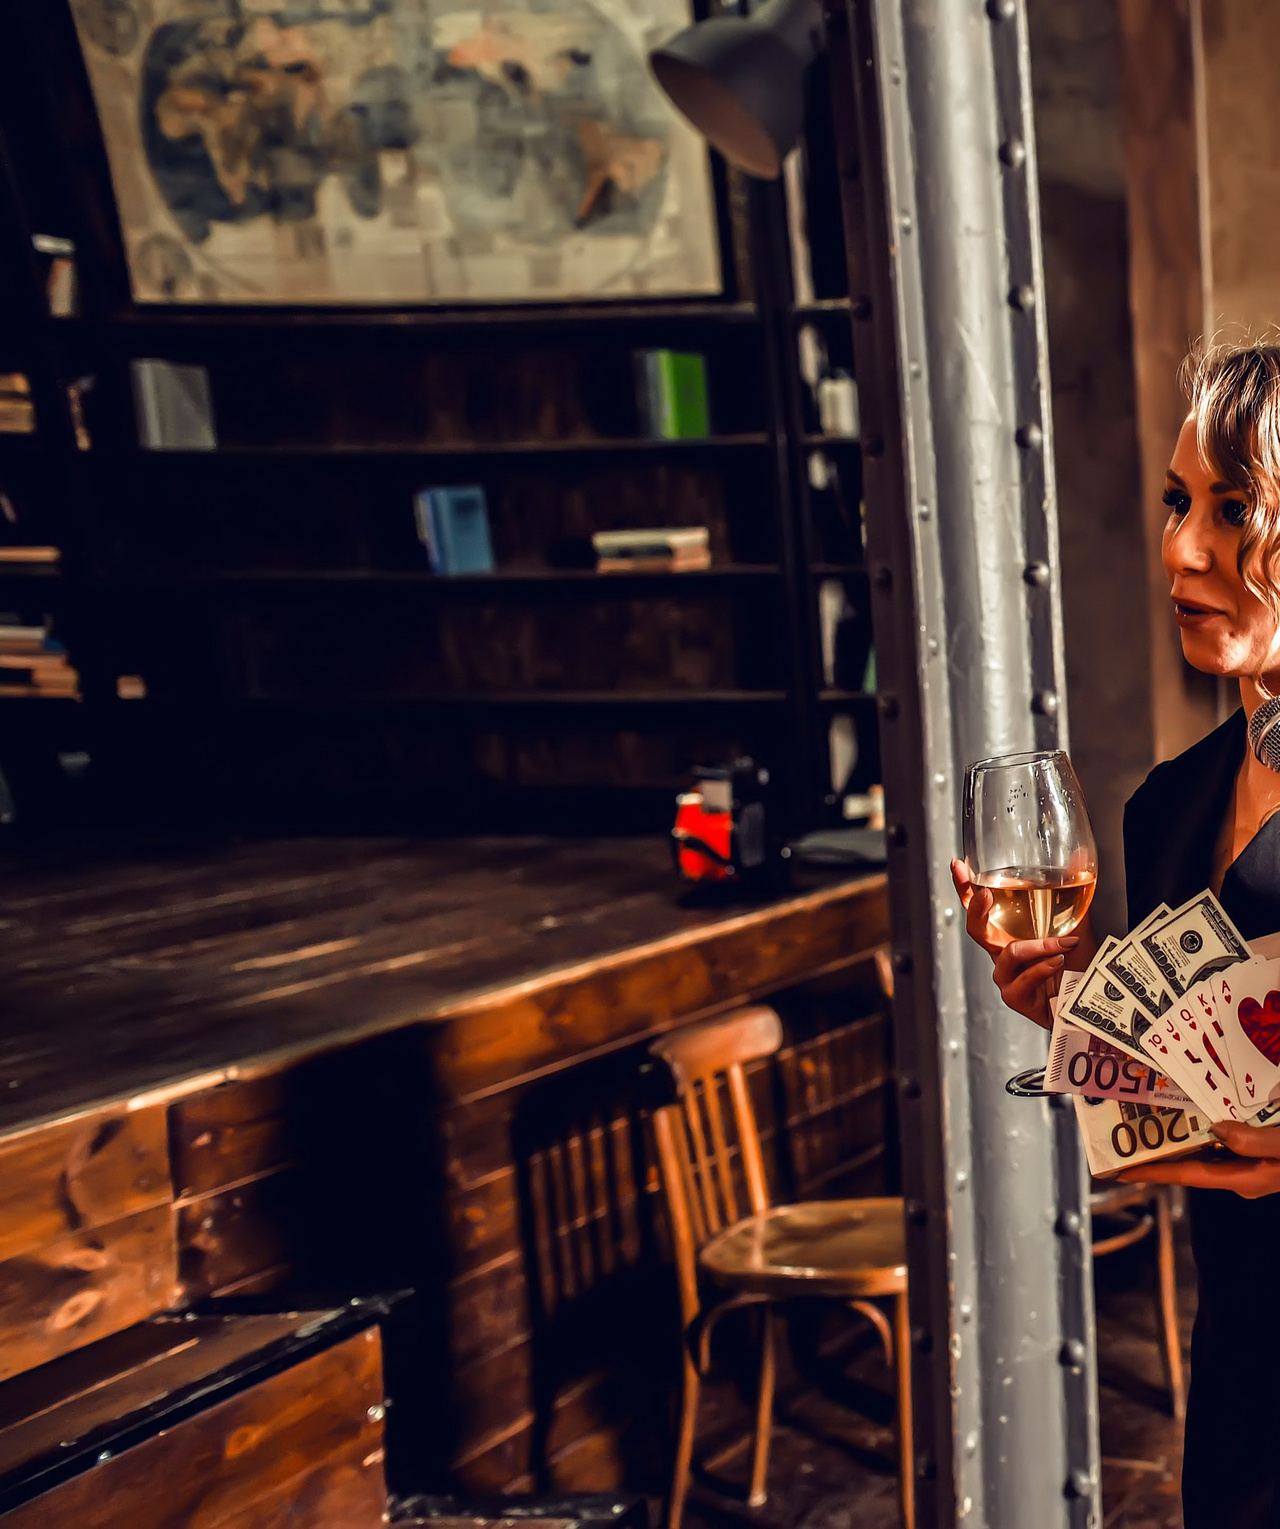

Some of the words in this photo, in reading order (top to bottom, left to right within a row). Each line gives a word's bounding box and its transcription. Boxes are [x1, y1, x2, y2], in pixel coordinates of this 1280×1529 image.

[1150, 943, 1177, 980] 100
[1114, 965, 1147, 999] 100
[1221, 980, 1231, 994] A
[1197, 993, 1208, 1007] K
[1080, 1006, 1117, 1034] 100
[1180, 1008, 1194, 1022] Q
[1166, 1020, 1175, 1033] J
[1148, 1034, 1163, 1048] 10
[1068, 1051, 1140, 1094] 500
[1245, 1084, 1255, 1099] A
[1229, 1106, 1238, 1120] J
[1111, 1109, 1190, 1158] 200
